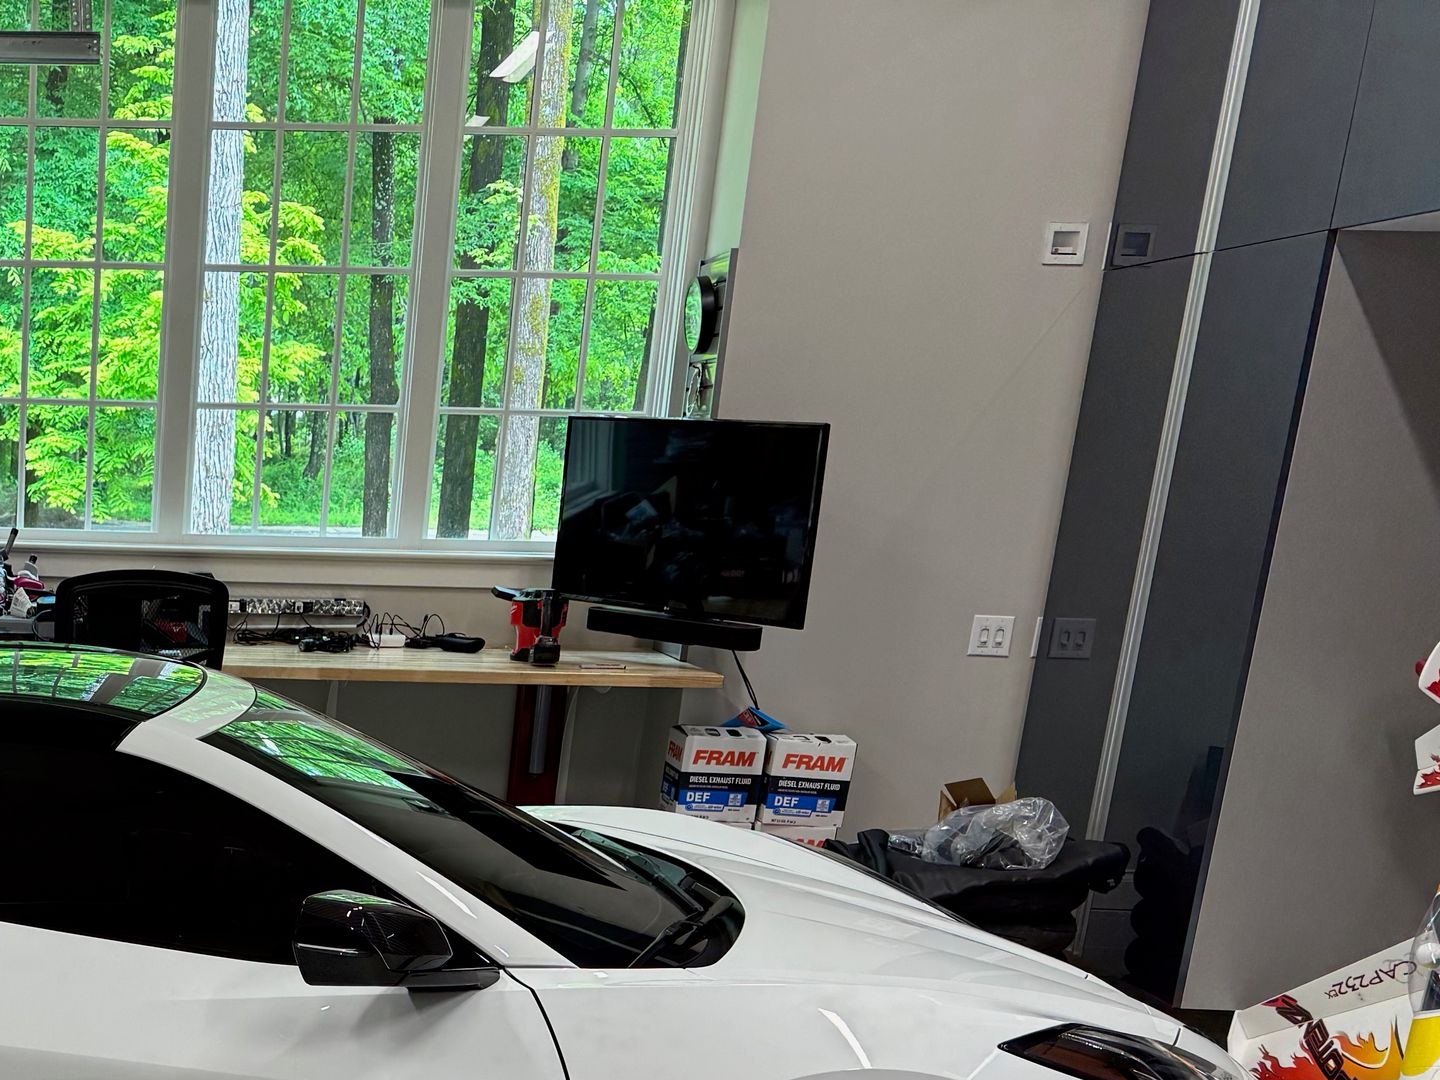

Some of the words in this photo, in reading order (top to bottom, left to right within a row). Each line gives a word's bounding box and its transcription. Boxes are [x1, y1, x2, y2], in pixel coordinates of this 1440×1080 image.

[692, 749, 757, 767] FRAM
[781, 753, 847, 773] FRAM
[689, 775, 708, 784] DIESEL
[709, 776, 735, 785] EXHAUST
[735, 777, 752, 786] FLUID
[778, 779, 797, 788] DIESEL
[798, 780, 823, 790] EXHAUST
[824, 782, 841, 791] FLUID
[686, 791, 711, 803] DEF
[774, 796, 800, 808] DEF
